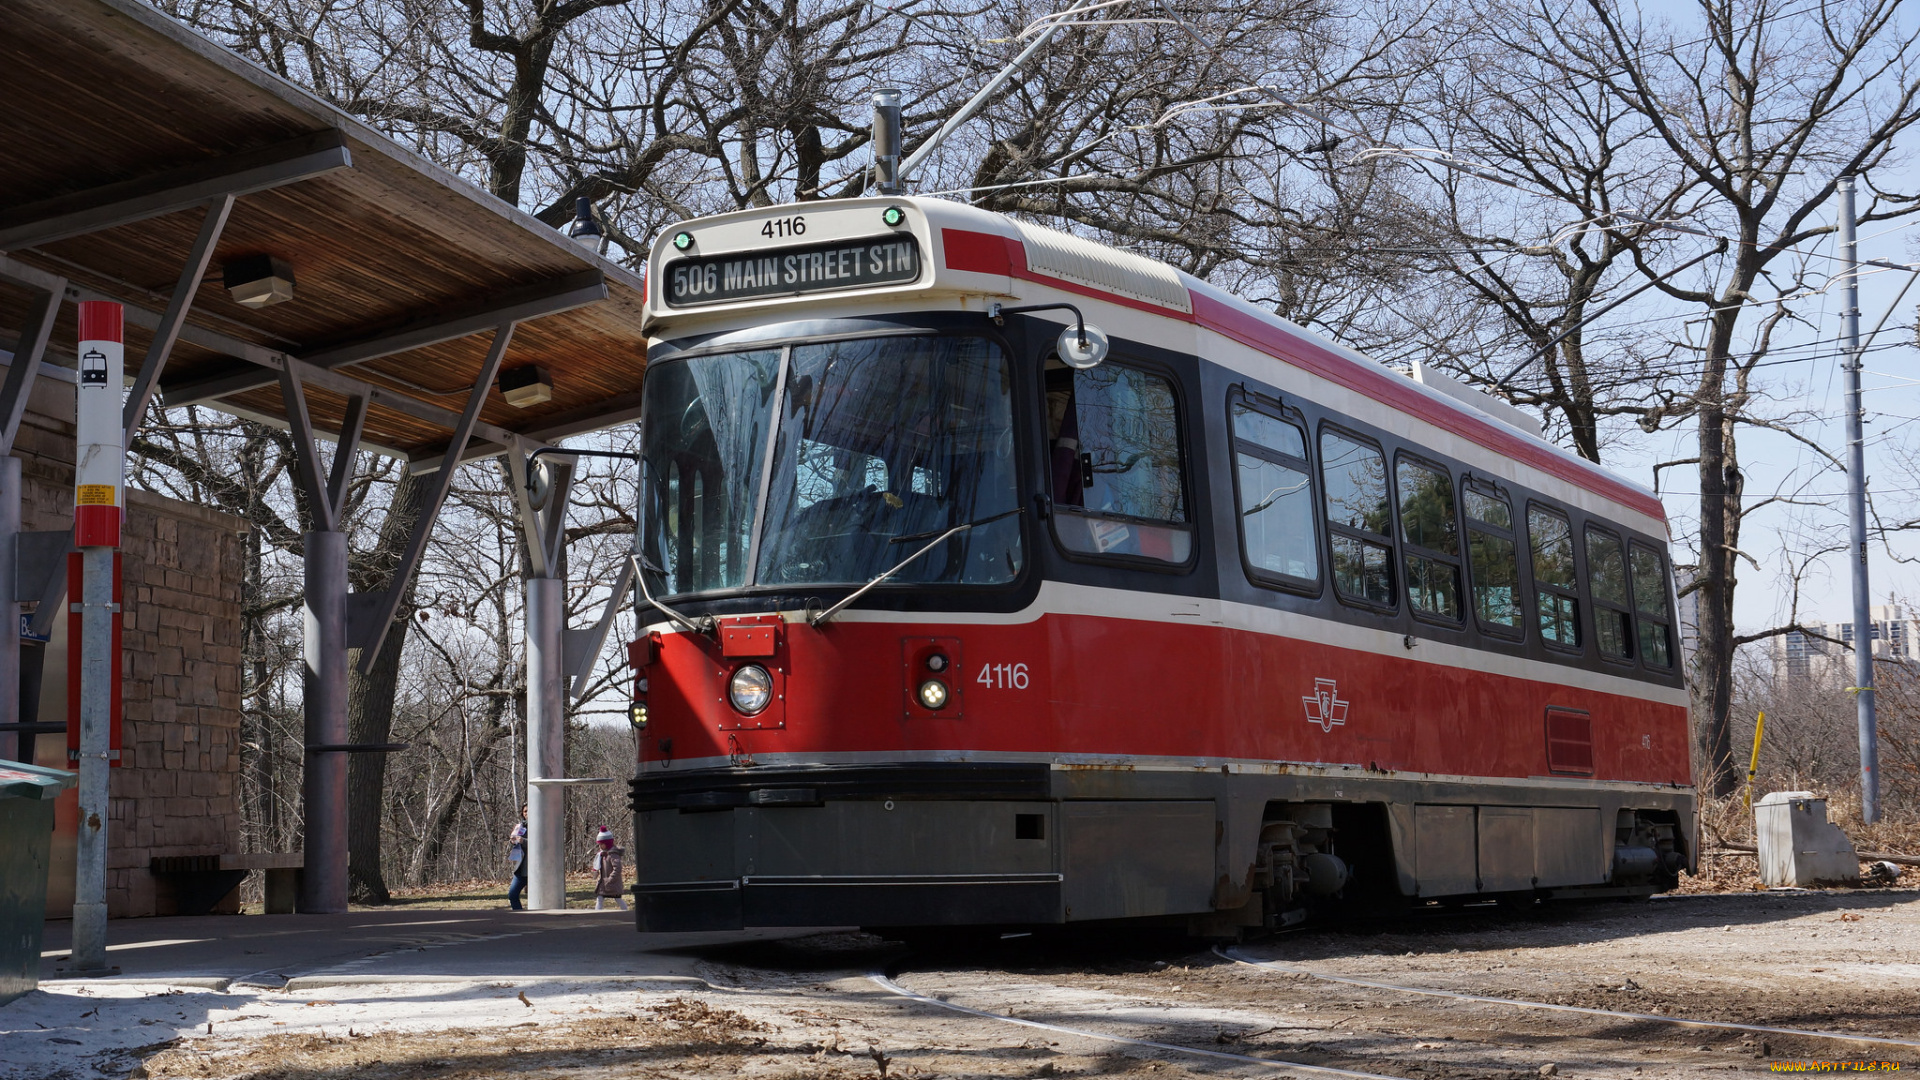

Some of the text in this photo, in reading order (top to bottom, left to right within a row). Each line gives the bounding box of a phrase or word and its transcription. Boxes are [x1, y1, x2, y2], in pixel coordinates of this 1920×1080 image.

[761, 216, 806, 239] 4116
[674, 242, 911, 297] 506 MAIN STREET STN
[976, 662, 1030, 690] 4116
